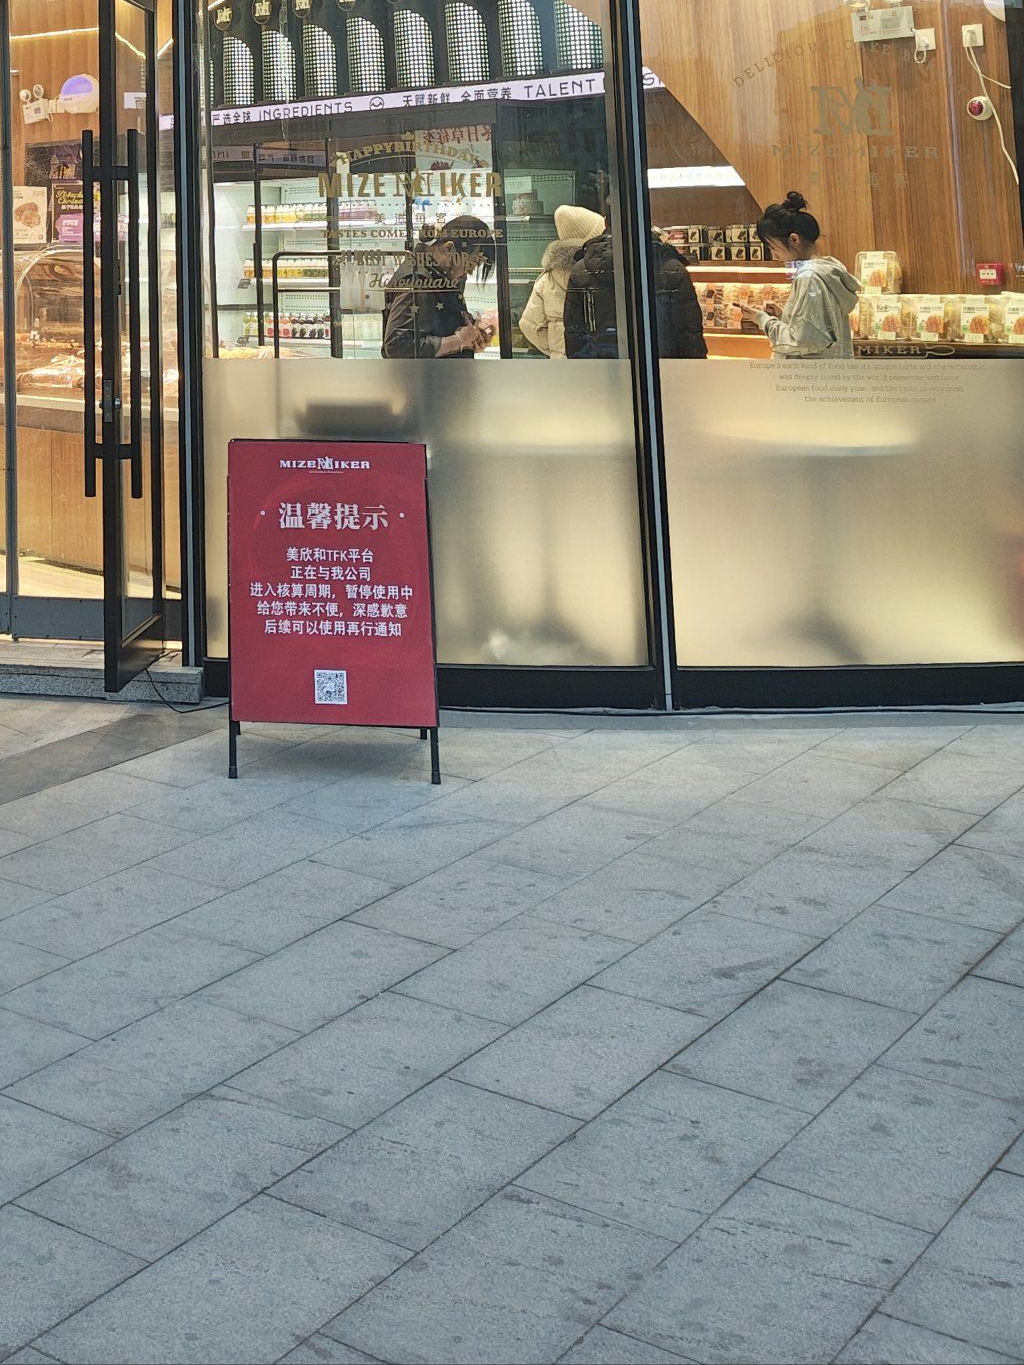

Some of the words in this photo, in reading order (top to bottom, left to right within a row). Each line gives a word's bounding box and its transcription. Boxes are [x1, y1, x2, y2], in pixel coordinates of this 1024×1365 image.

[524, 78, 596, 99] TALENT
[258, 101, 353, 121] INGREDIENTS
[321, 229, 367, 239] TASTES
[371, 229, 406, 239] COME
[452, 229, 503, 239] EUROPE
[279, 455, 371, 470] MIZEMIKER
[278, 501, 389, 531] 温馨提示
[286, 546, 374, 563] 美欣和TFK平台
[290, 565, 371, 582] 正在与我公司
[264, 619, 402, 638] 后续可以使用再行通知
